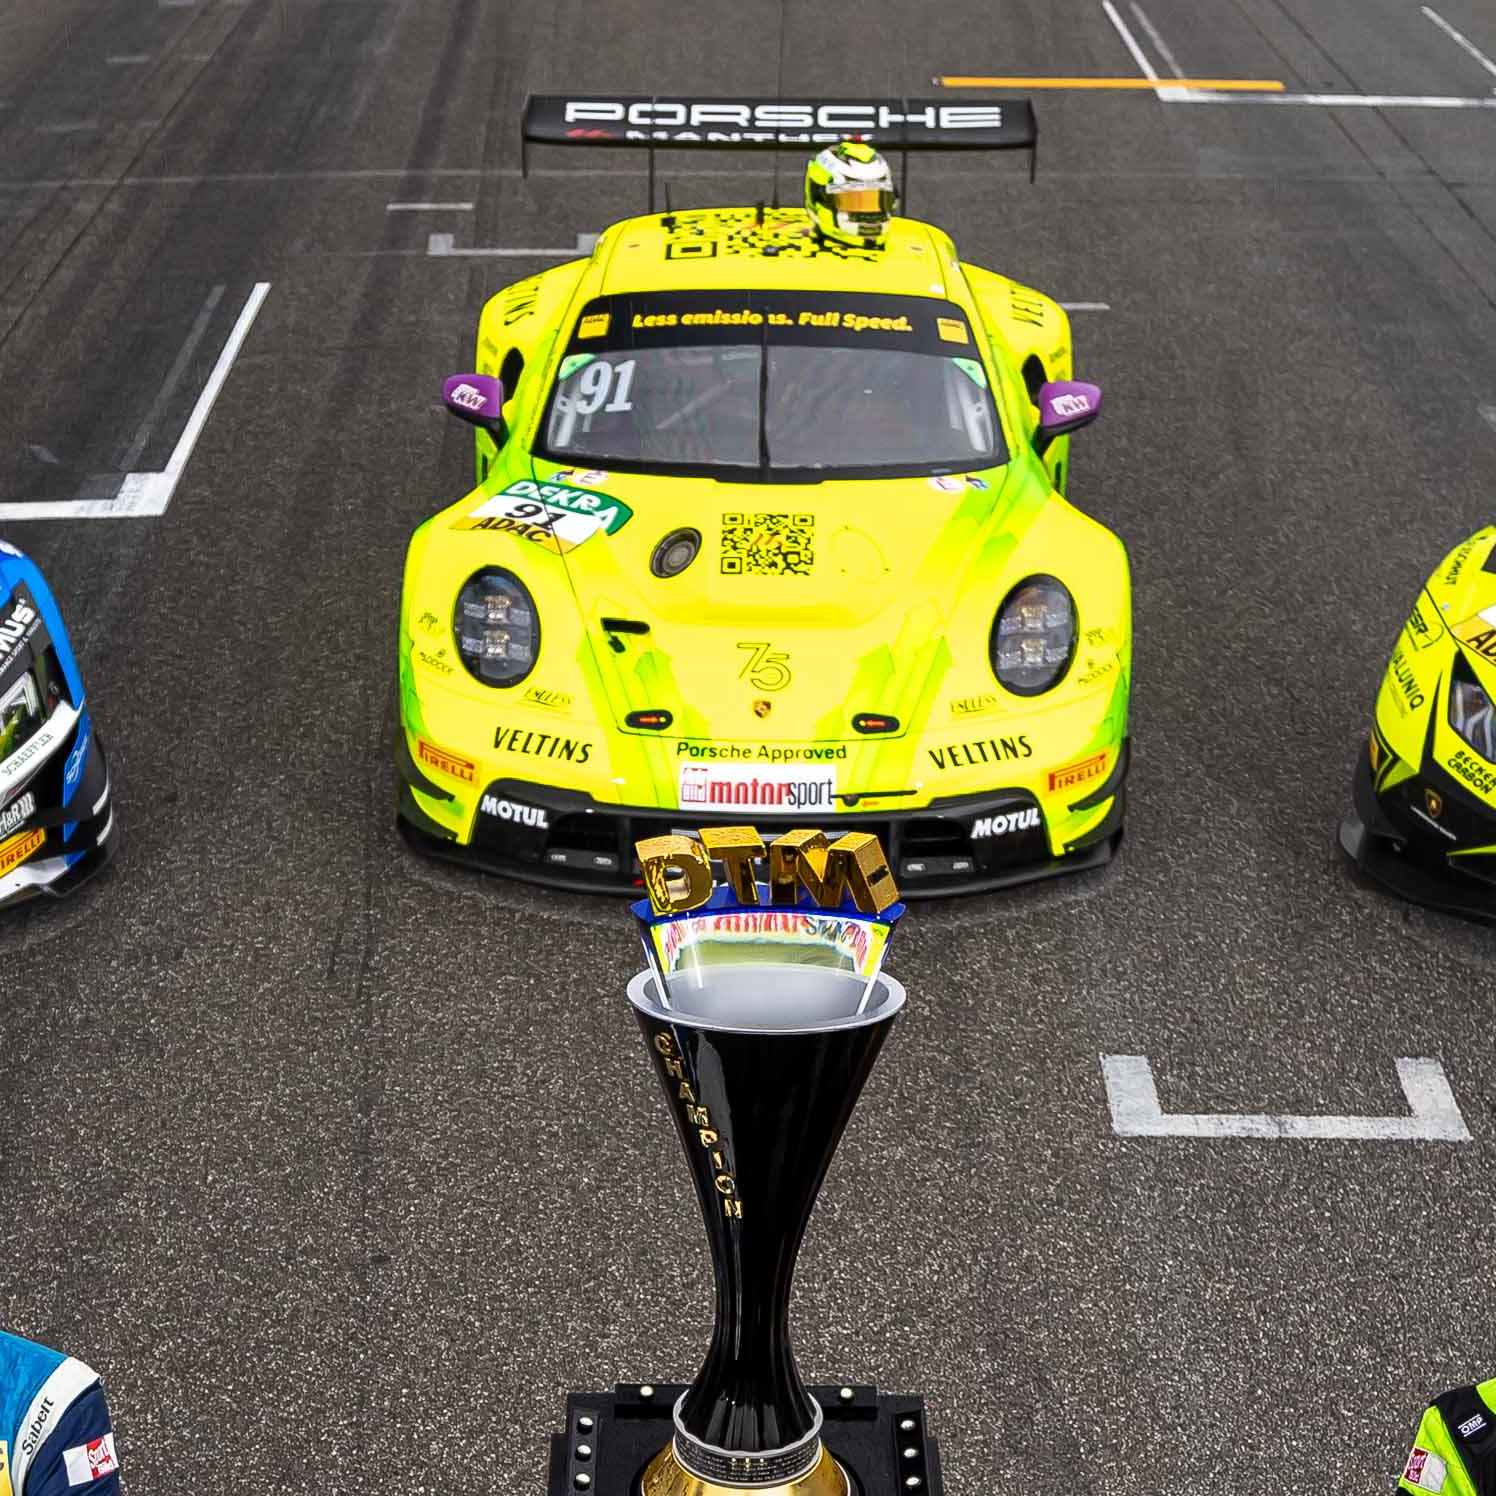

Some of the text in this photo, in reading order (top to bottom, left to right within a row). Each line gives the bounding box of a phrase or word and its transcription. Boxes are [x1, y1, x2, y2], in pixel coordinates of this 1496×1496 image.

[563, 101, 1003, 129] PORSCHE
[632, 312, 678, 328] Less
[798, 311, 840, 328] Full
[842, 313, 913, 332] Speed.
[578, 359, 637, 415] 91
[504, 480, 619, 532] DEKRA
[505, 503, 567, 531] 91
[471, 516, 552, 543] ADAC
[736, 642, 792, 692] 75
[1390, 653, 1425, 712] ALUNIQ
[418, 739, 475, 782] PIRELLI
[492, 725, 593, 764] VELTINS
[676, 741, 847, 763] Porsche Approved
[927, 735, 1033, 771] VELTINS
[1047, 752, 1107, 793] PIRELLI
[1447, 758, 1493, 795] CARBON
[709, 777, 834, 809] motorsport
[479, 794, 550, 830] MOTUL
[969, 807, 1042, 840] MOTUL
[634, 825, 901, 917] DTM
[653, 1031, 744, 1220] CHAMPION
[21, 1396, 55, 1457] Sabelt
[1460, 1415, 1484, 1435] OMP
